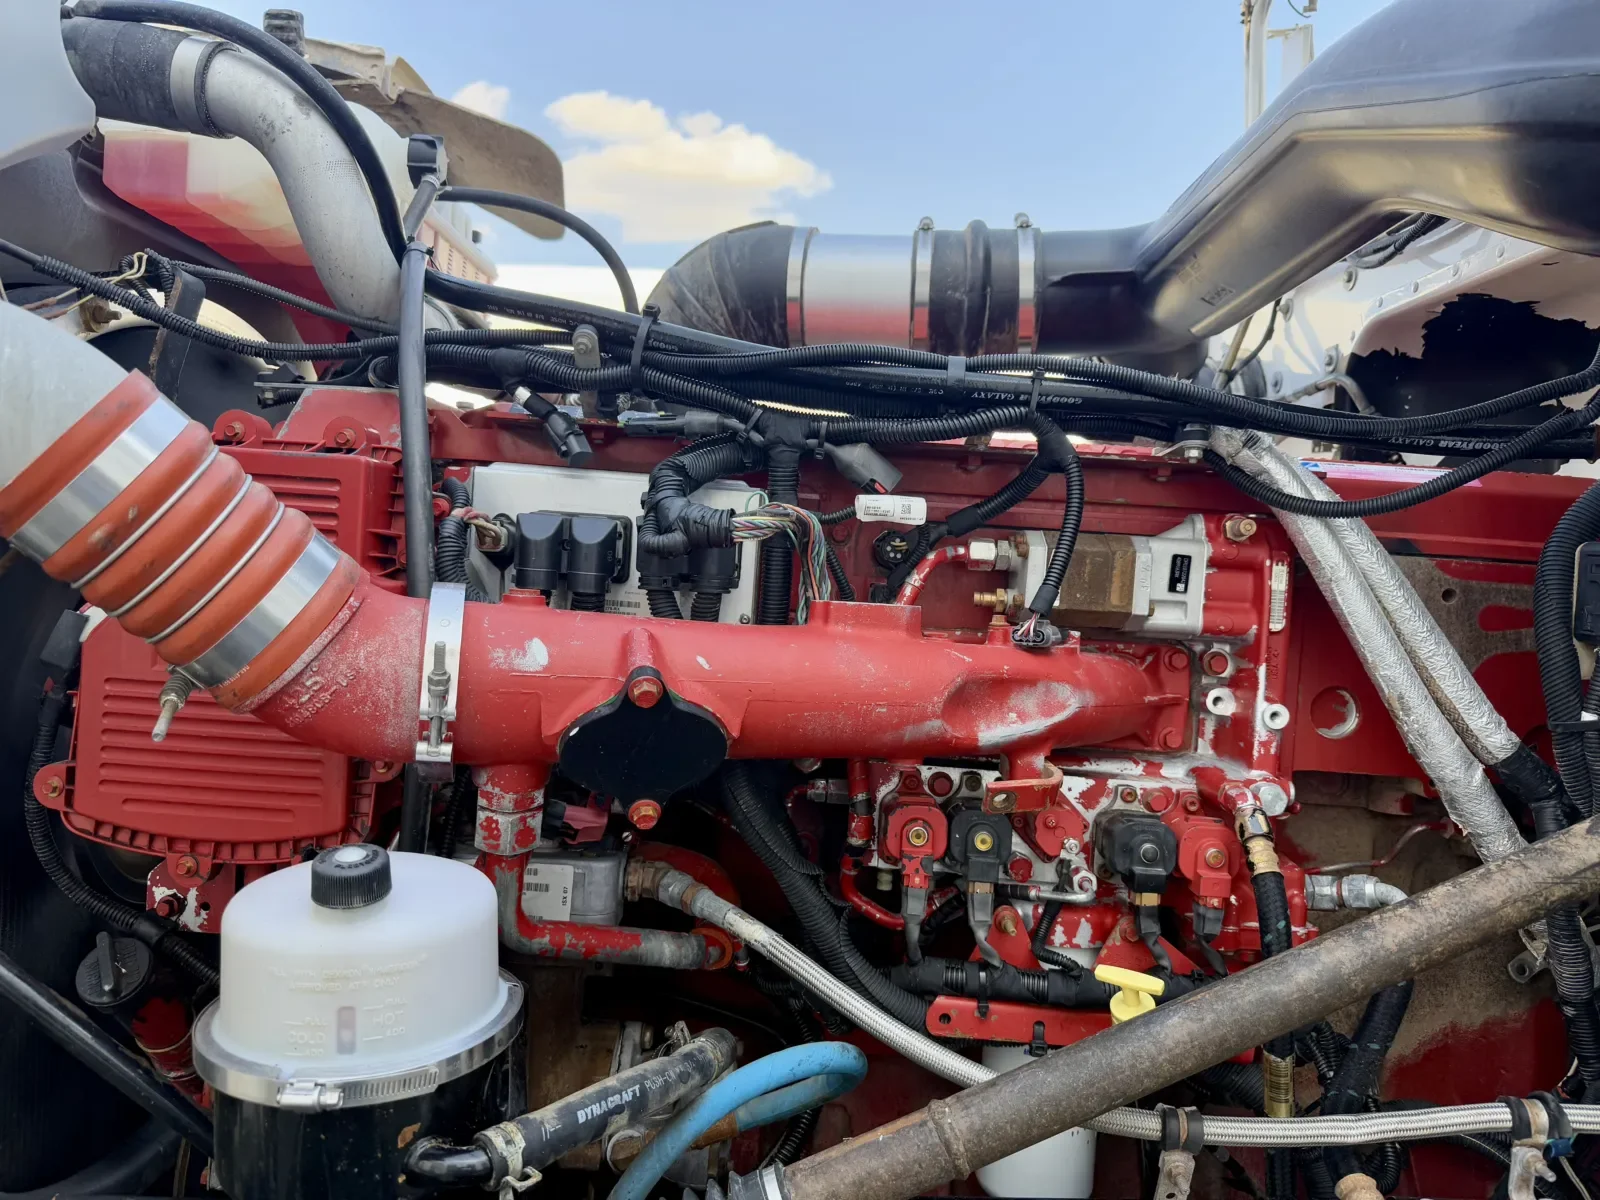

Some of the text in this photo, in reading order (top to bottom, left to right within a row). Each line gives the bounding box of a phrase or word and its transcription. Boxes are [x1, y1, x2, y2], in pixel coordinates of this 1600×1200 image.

[971, 391, 1015, 401] GALAXY
[1388, 436, 1435, 446] GALAXY
[373, 976, 401, 989] ONLY
[385, 996, 409, 1006] FULL
[303, 1016, 329, 1026] FULL
[372, 1010, 405, 1026] HOT
[287, 1030, 327, 1045] COLD
[385, 1026, 406, 1038] ADD
[305, 1047, 325, 1057] ADD
[576, 1084, 641, 1125] DYNACRAFT
